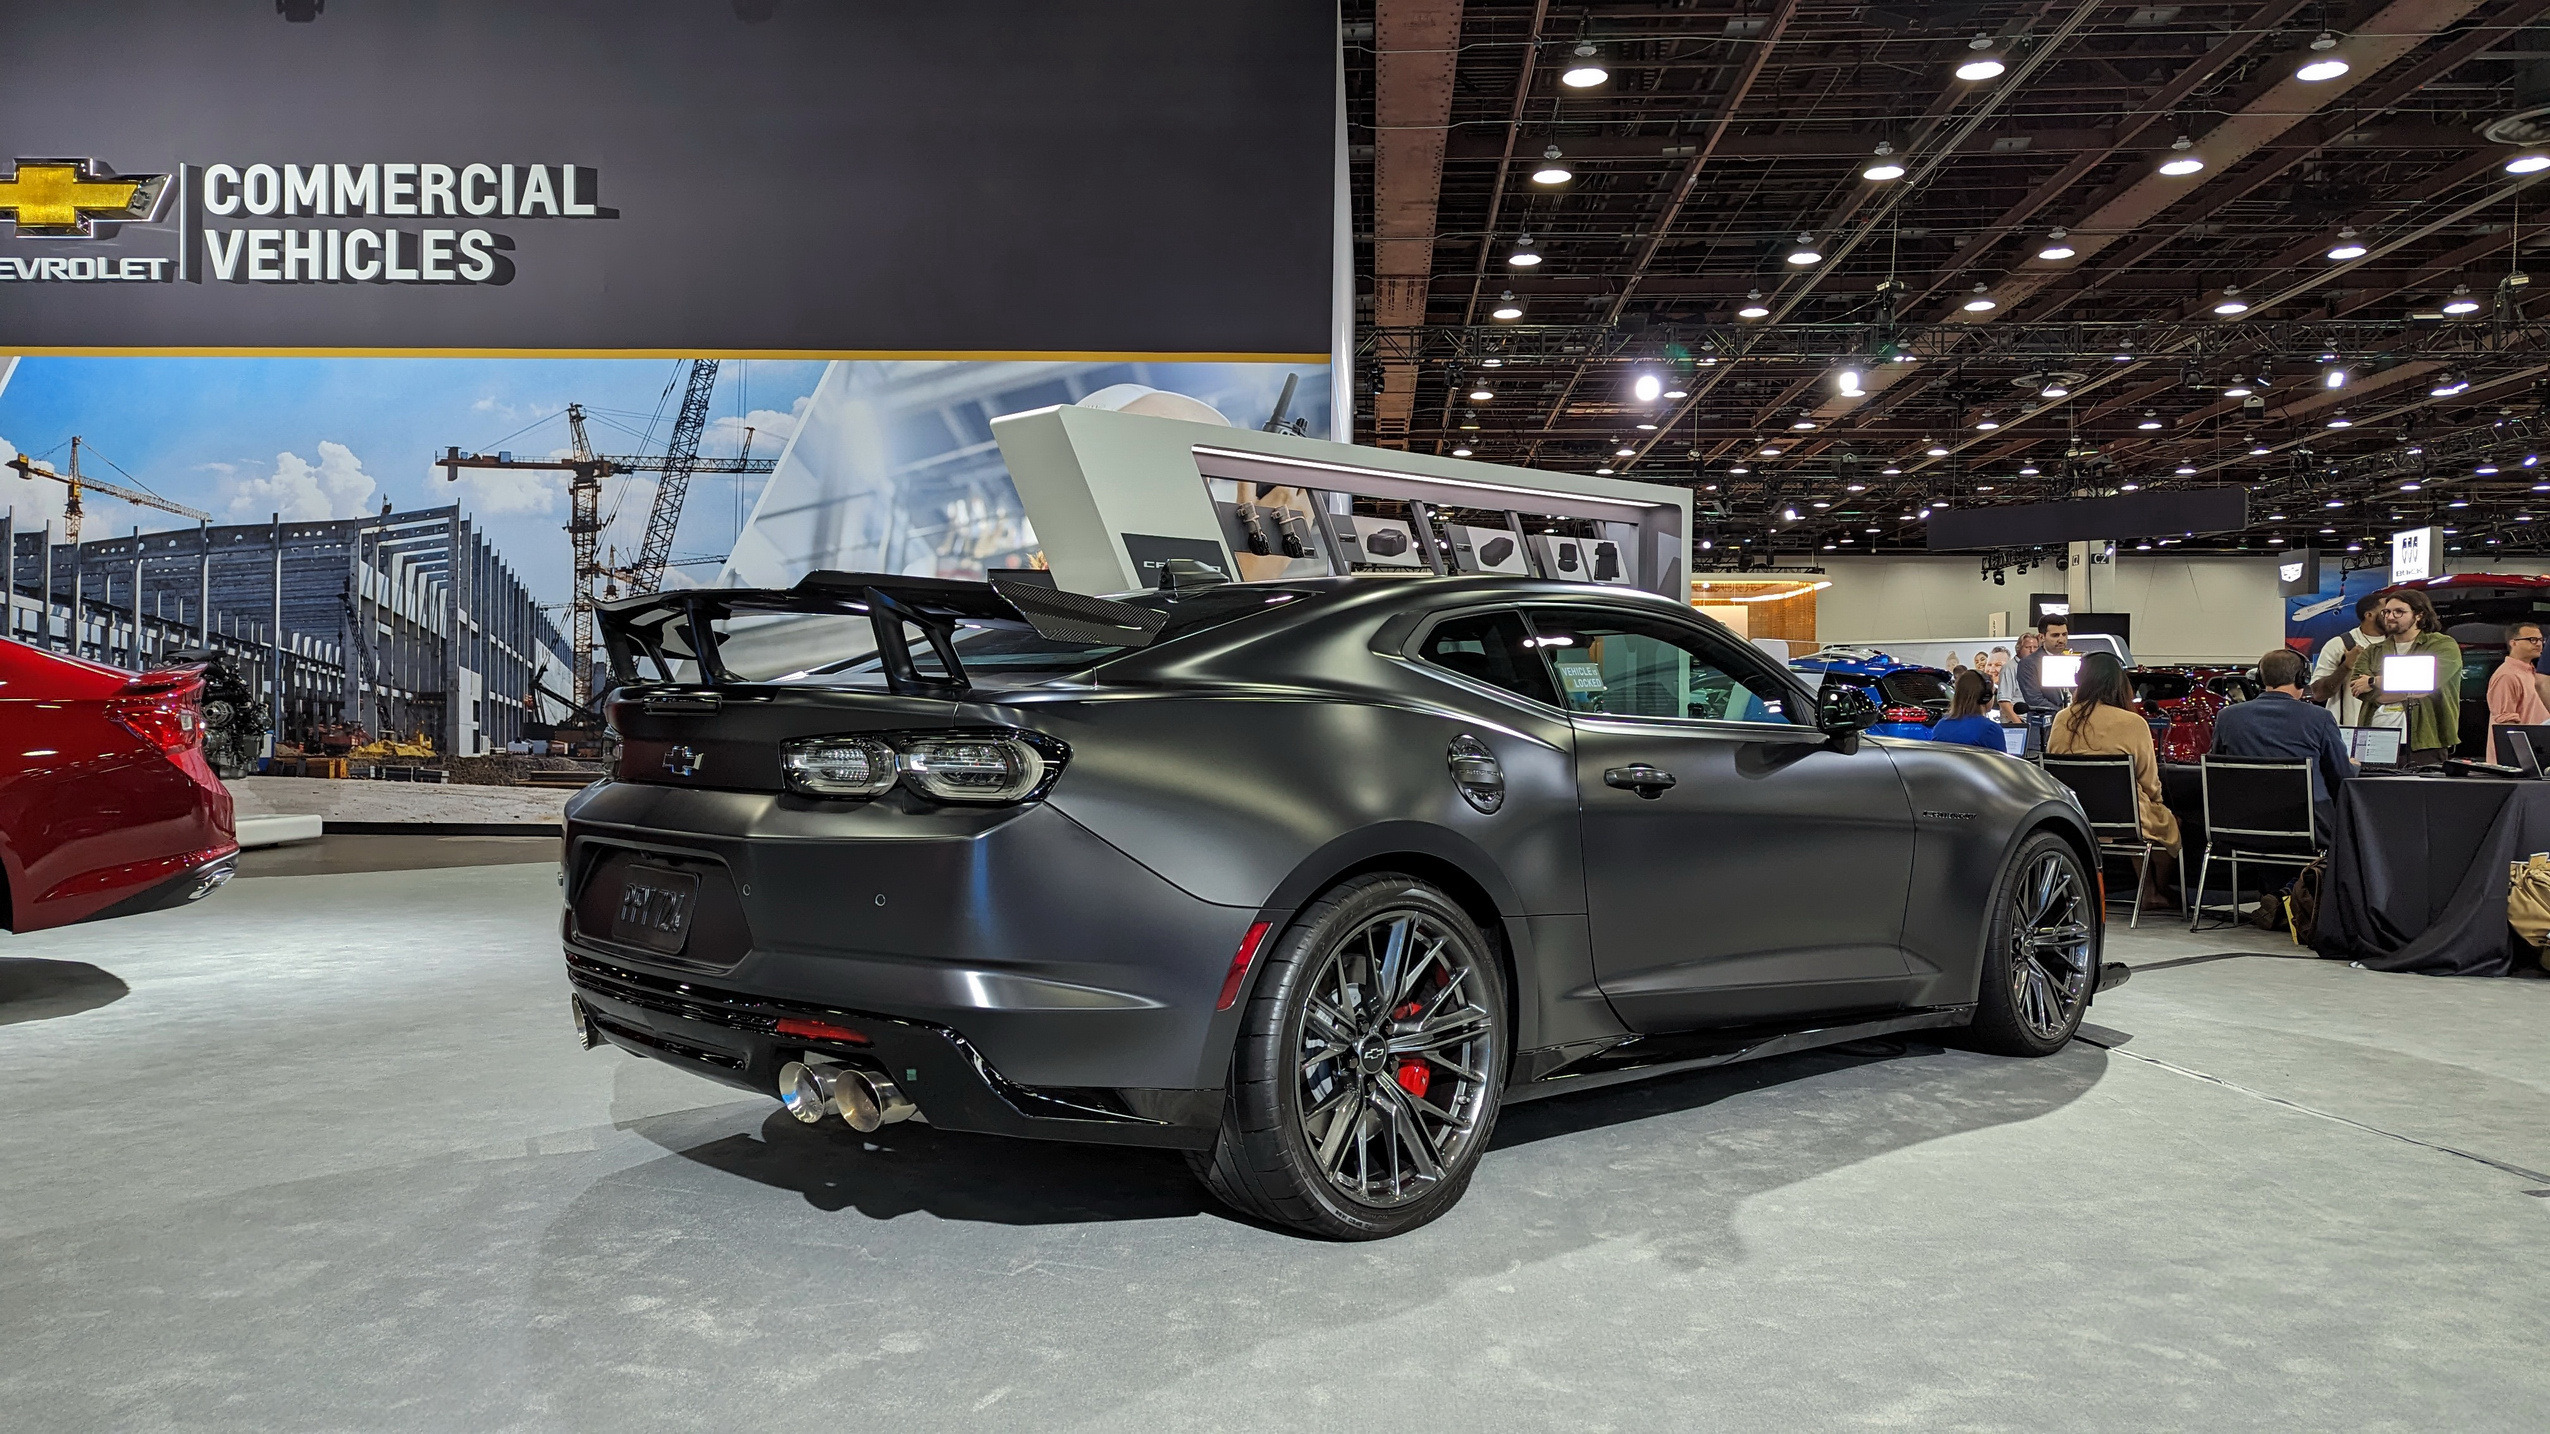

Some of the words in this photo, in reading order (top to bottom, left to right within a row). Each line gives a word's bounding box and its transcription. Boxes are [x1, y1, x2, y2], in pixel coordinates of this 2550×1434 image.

[204, 163, 597, 216] COMMERCIAL
[204, 228, 496, 281] VEHICLES
[2094, 554, 2107, 564] C2
[1562, 666, 1592, 676] VEHICLE
[1573, 678, 1602, 688] LOCKED
